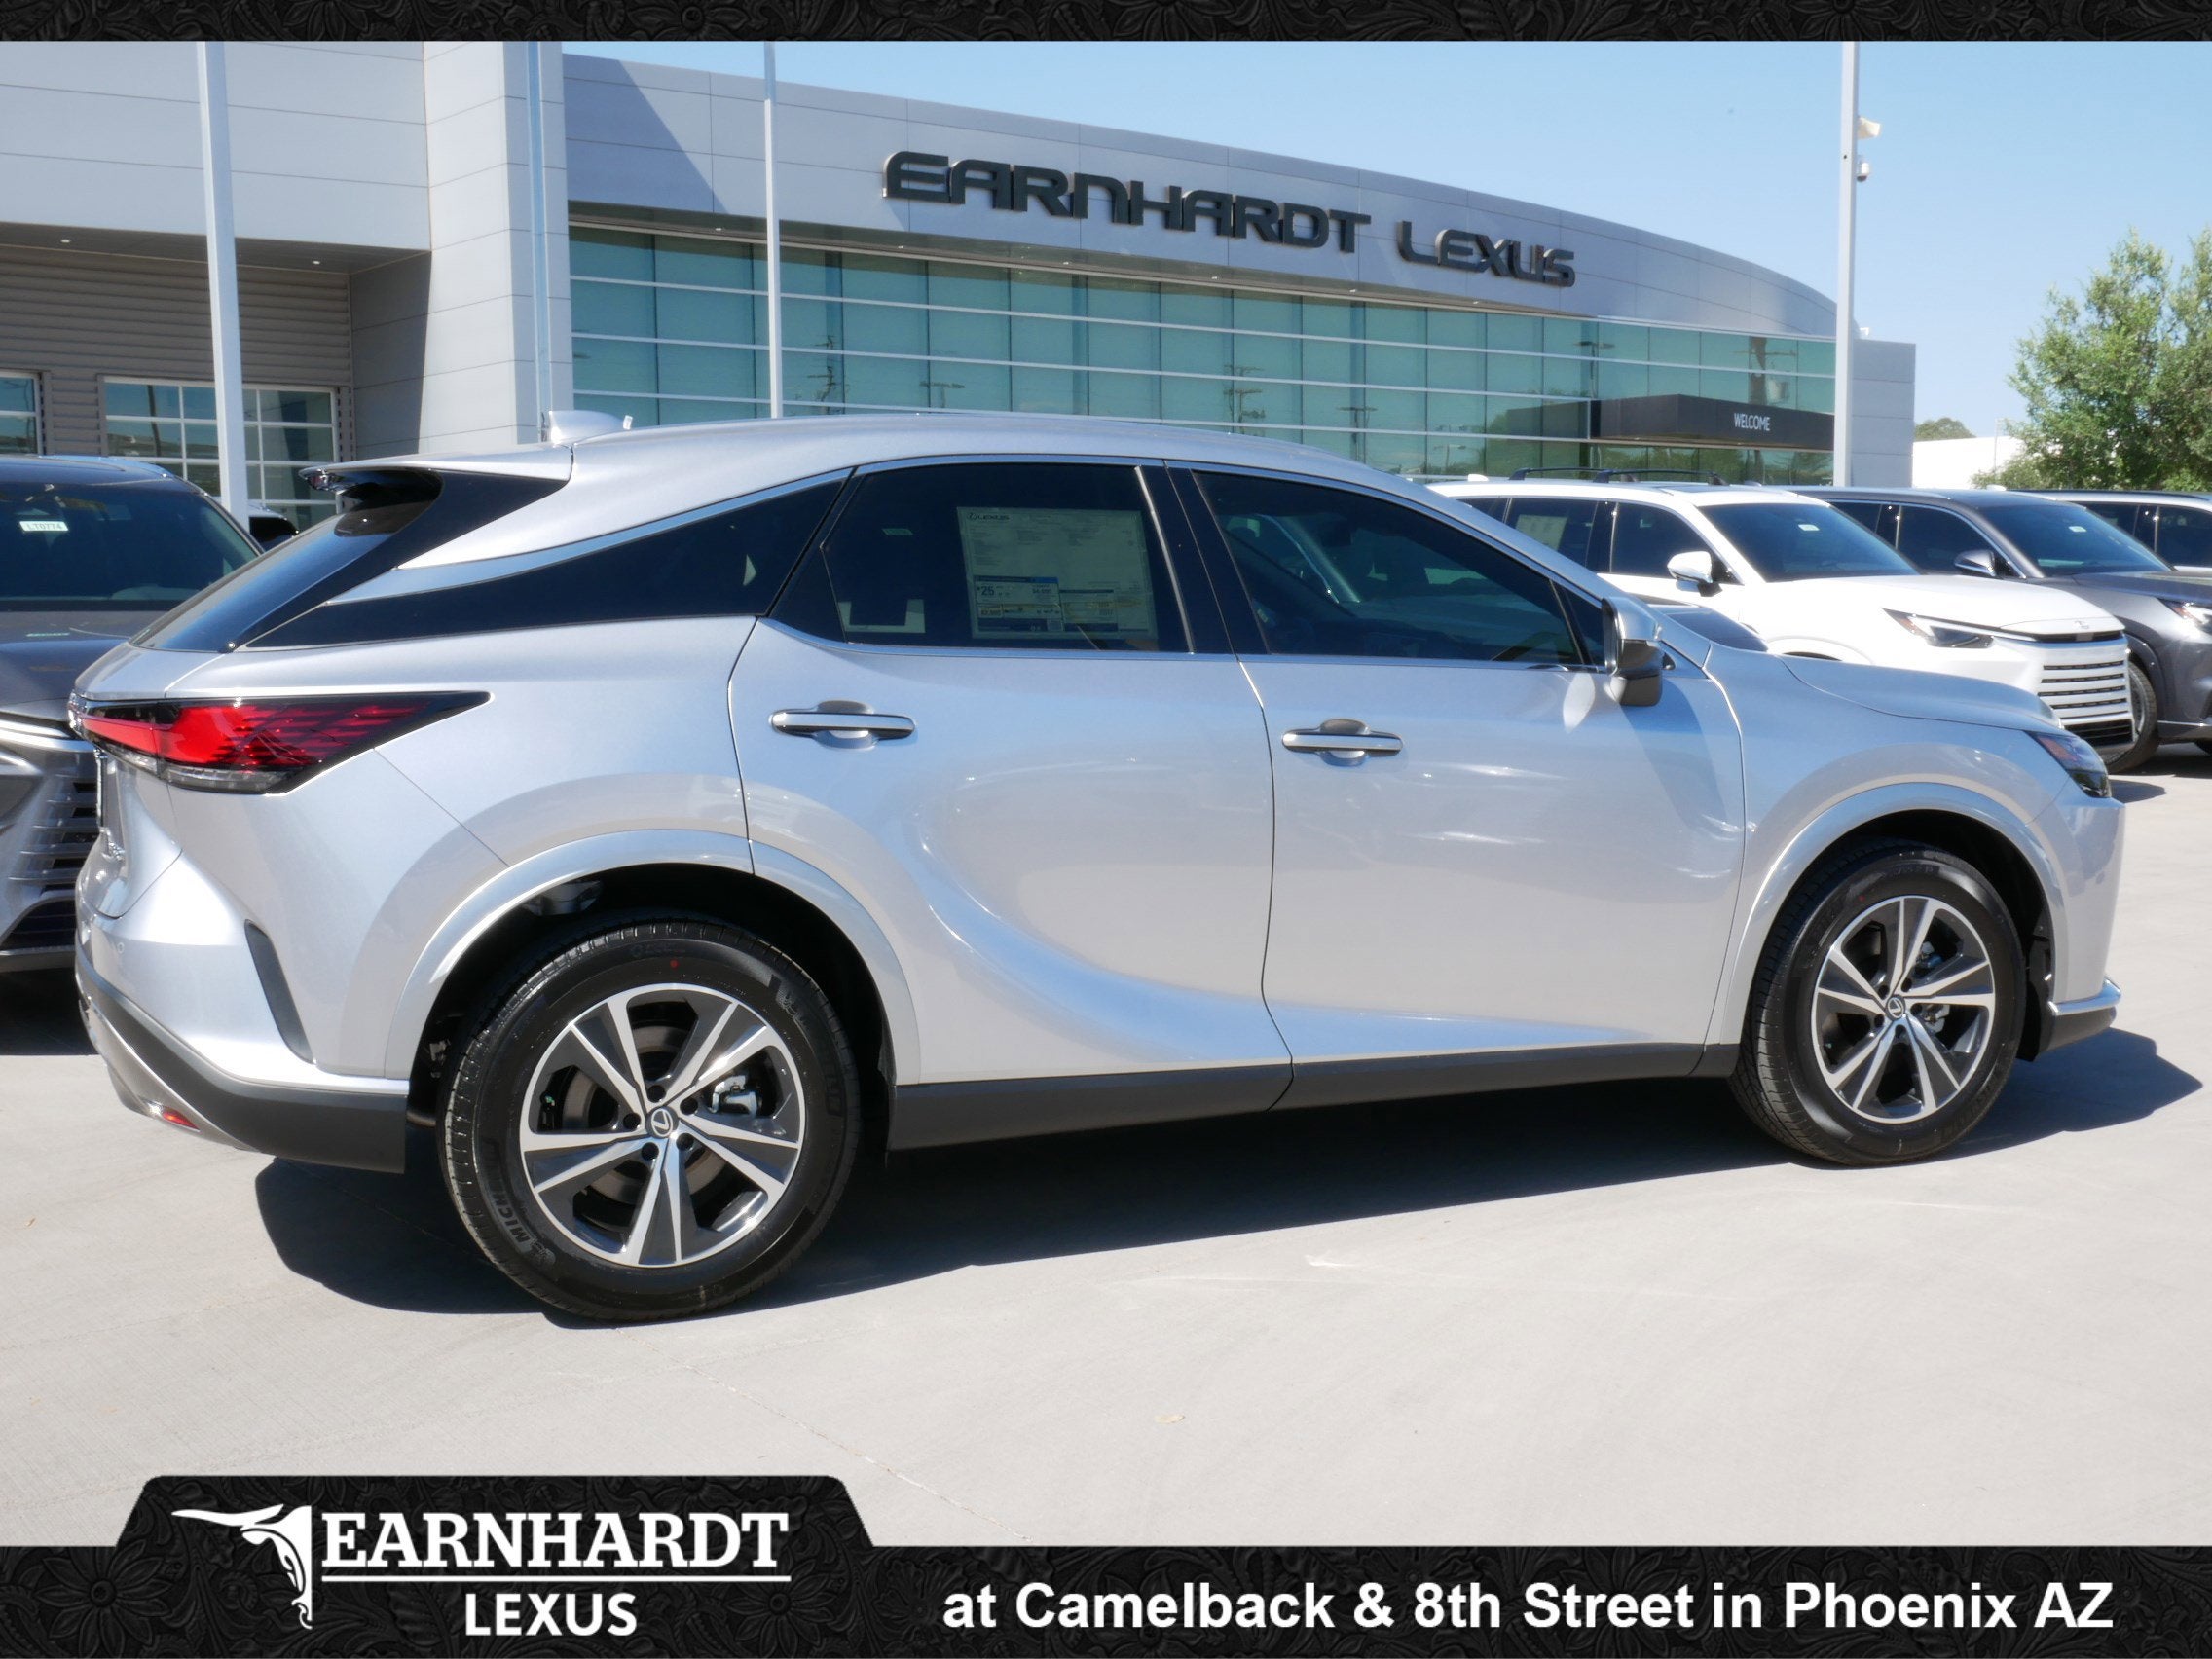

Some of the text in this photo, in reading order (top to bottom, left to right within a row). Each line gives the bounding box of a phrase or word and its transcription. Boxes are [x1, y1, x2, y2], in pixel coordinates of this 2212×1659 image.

[883, 151, 1576, 287] EARNHARDT LEXUS
[1734, 413, 1771, 431] WELCOME
